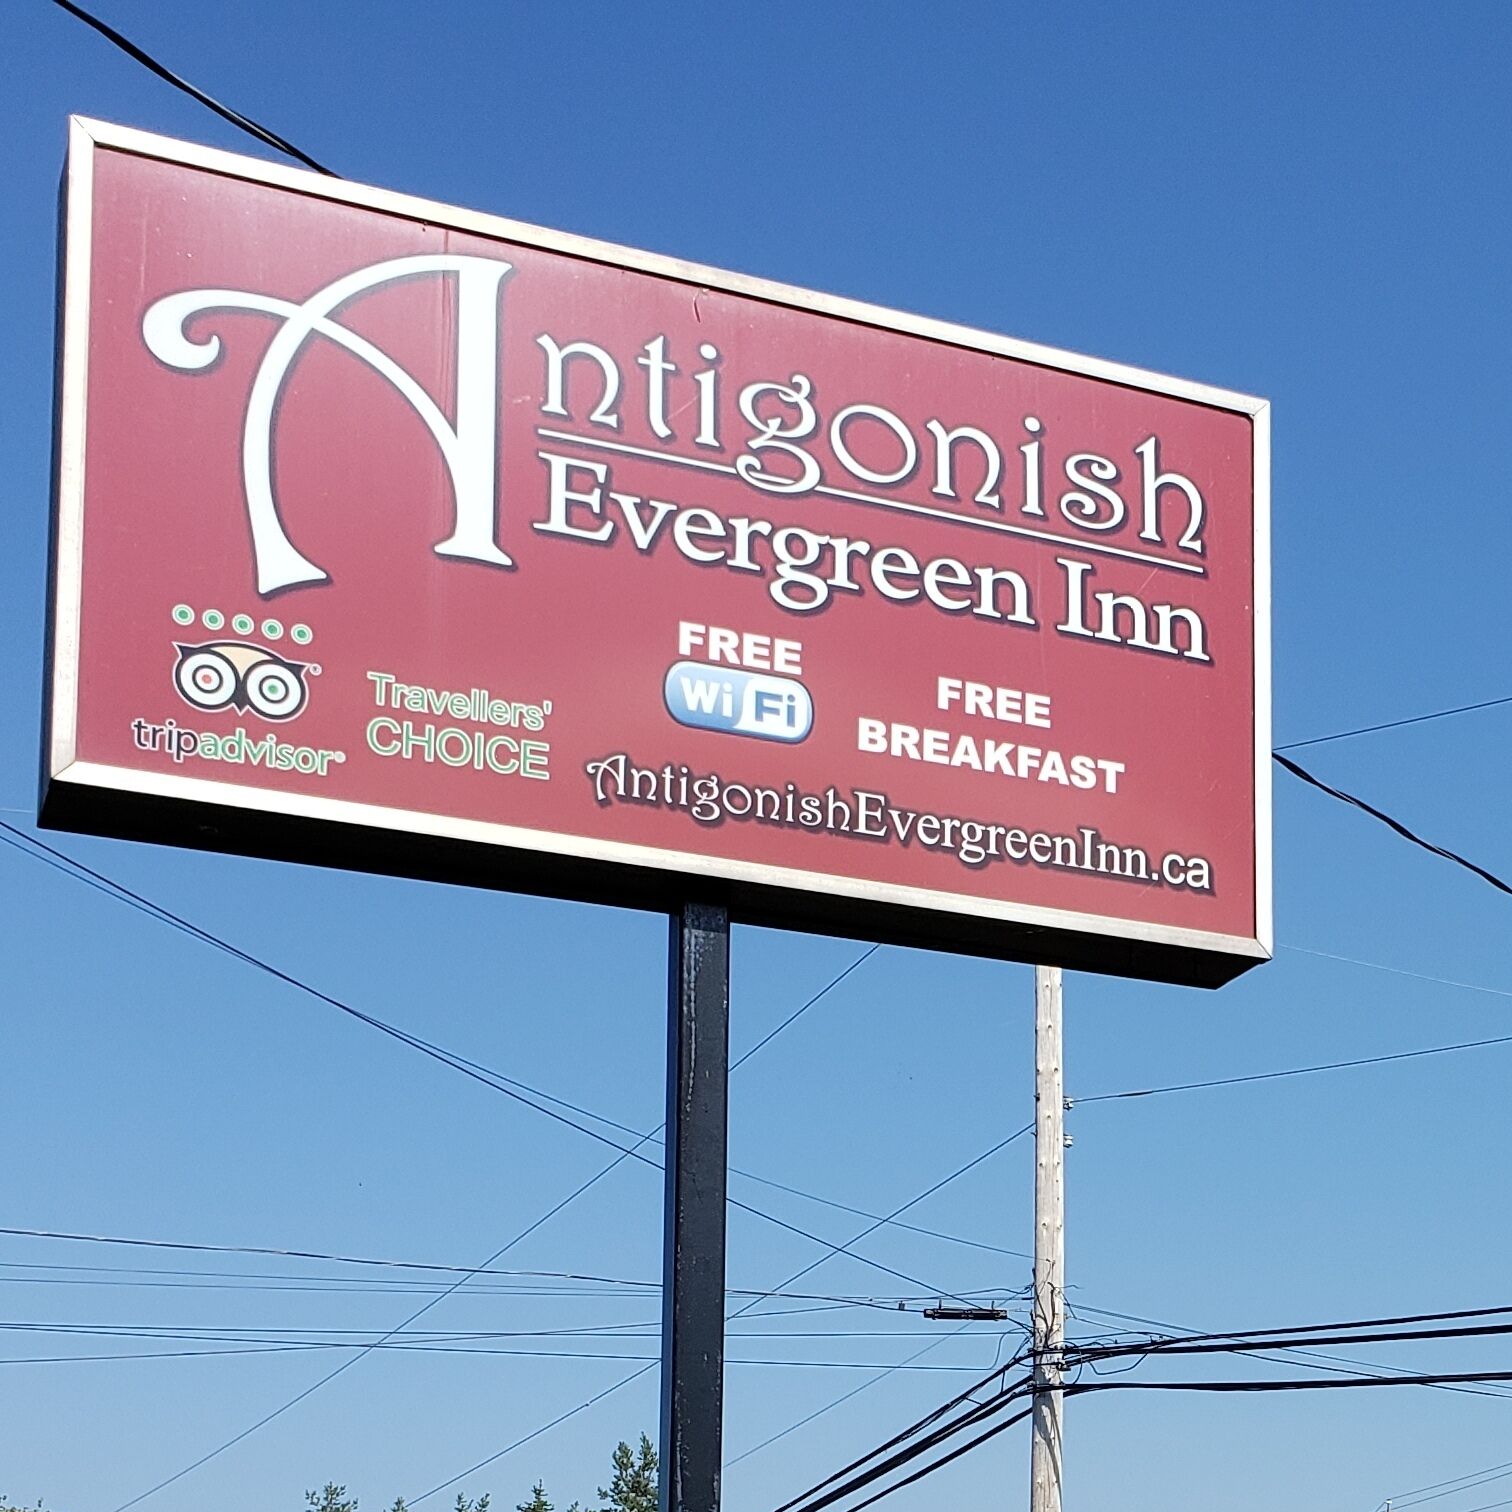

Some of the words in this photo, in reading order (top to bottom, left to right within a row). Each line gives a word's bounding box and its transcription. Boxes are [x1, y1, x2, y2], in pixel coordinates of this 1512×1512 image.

[142, 253, 1207, 597] Antigonish
[532, 449, 1036, 612] Evergreen
[1056, 556, 1211, 662] Inn
[677, 621, 803, 675] FREE
[936, 676, 1052, 729] FREE
[366, 718, 551, 780] CHOICE
[857, 717, 1126, 794] BREAKFAST
[586, 754, 1212, 892] AntigonishEvergreenInn.ca
